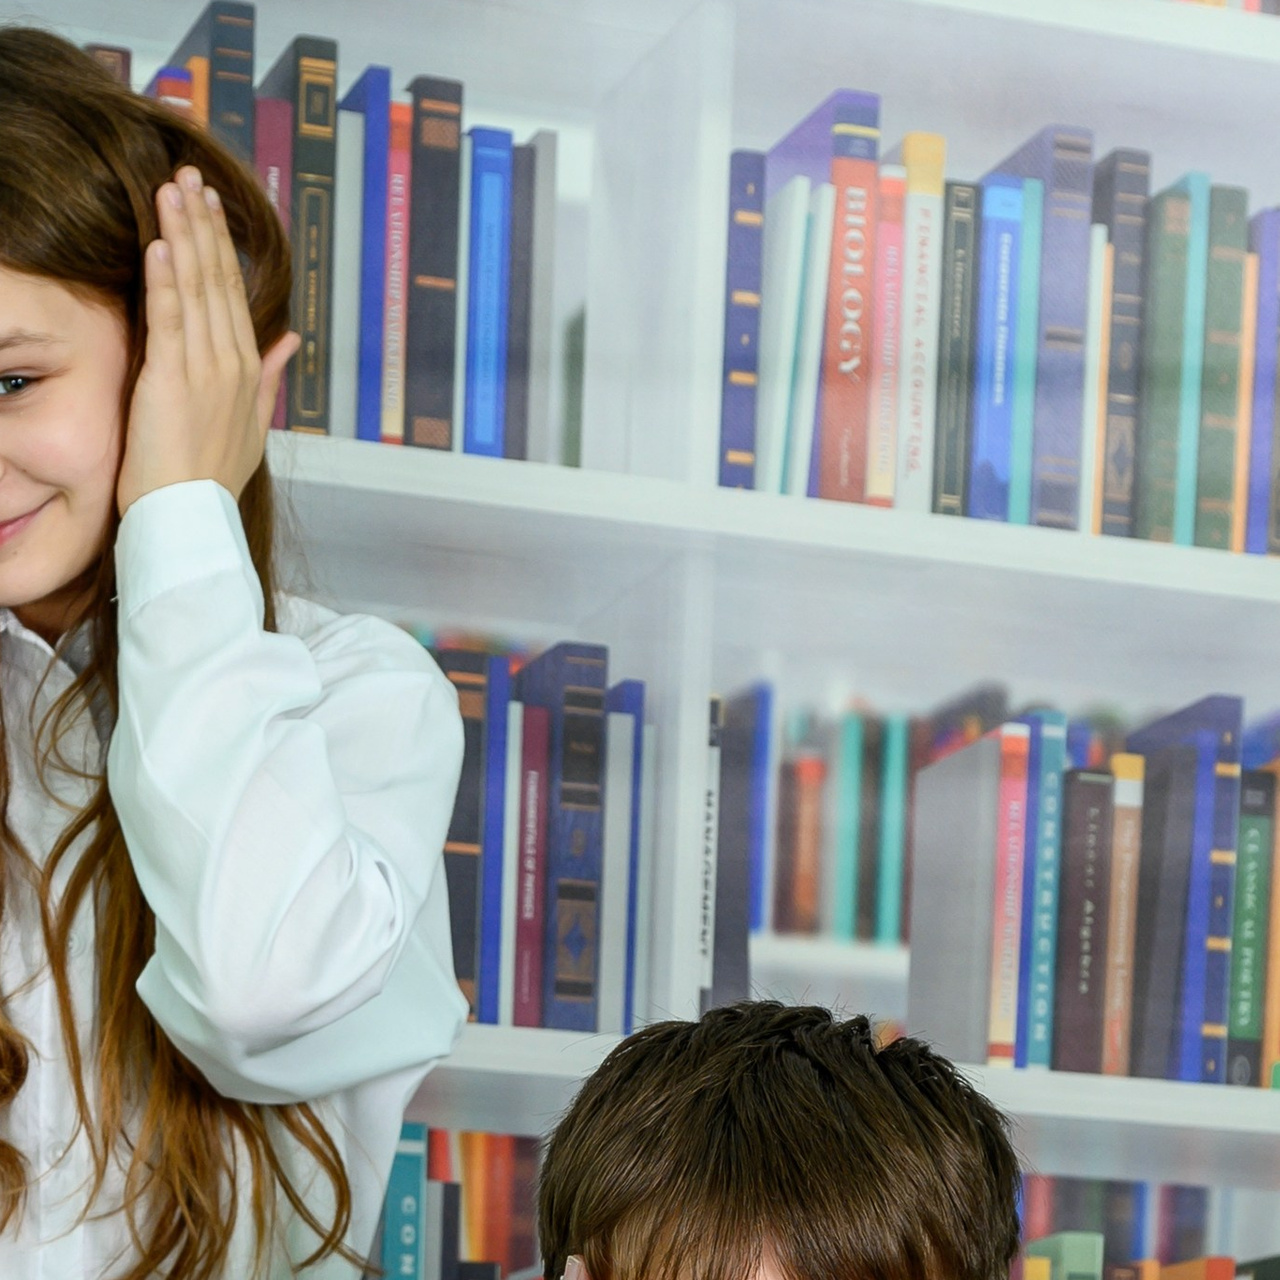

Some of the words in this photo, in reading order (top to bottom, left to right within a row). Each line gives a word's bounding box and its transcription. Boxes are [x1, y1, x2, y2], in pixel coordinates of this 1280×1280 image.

[836, 185, 868, 385] BIOLOGY
[913, 206, 933, 329] FINANCIAL
[700, 788, 715, 958] MANAGEMENT
[1033, 771, 1058, 1042] CONSTRUCTION
[1085, 806, 1100, 888] Linear
[1077, 898, 1095, 995] Algebra
